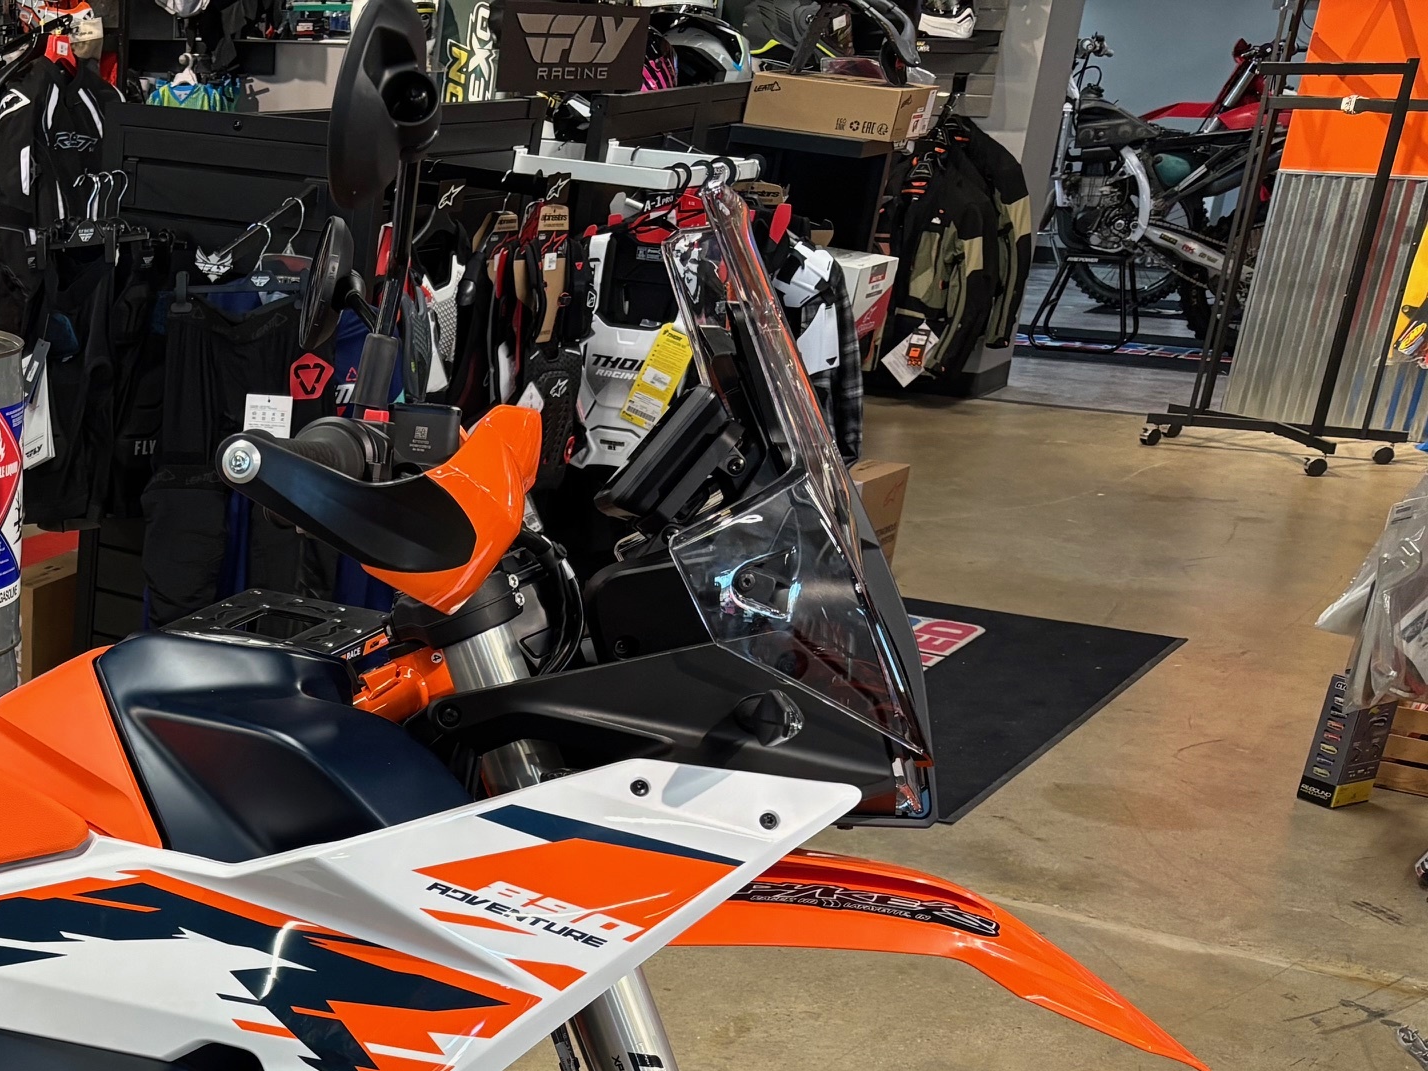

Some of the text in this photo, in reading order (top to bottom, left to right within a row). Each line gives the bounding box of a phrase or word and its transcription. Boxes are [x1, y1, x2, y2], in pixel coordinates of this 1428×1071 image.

[517, 13, 640, 63] FLY
[536, 67, 609, 80] RACING
[596, 370, 638, 381] RACIN
[134, 440, 157, 456] FLY
[346, 647, 361, 661] RACE
[426, 882, 608, 948] ADVENTURE
[475, 880, 645, 943] 890
